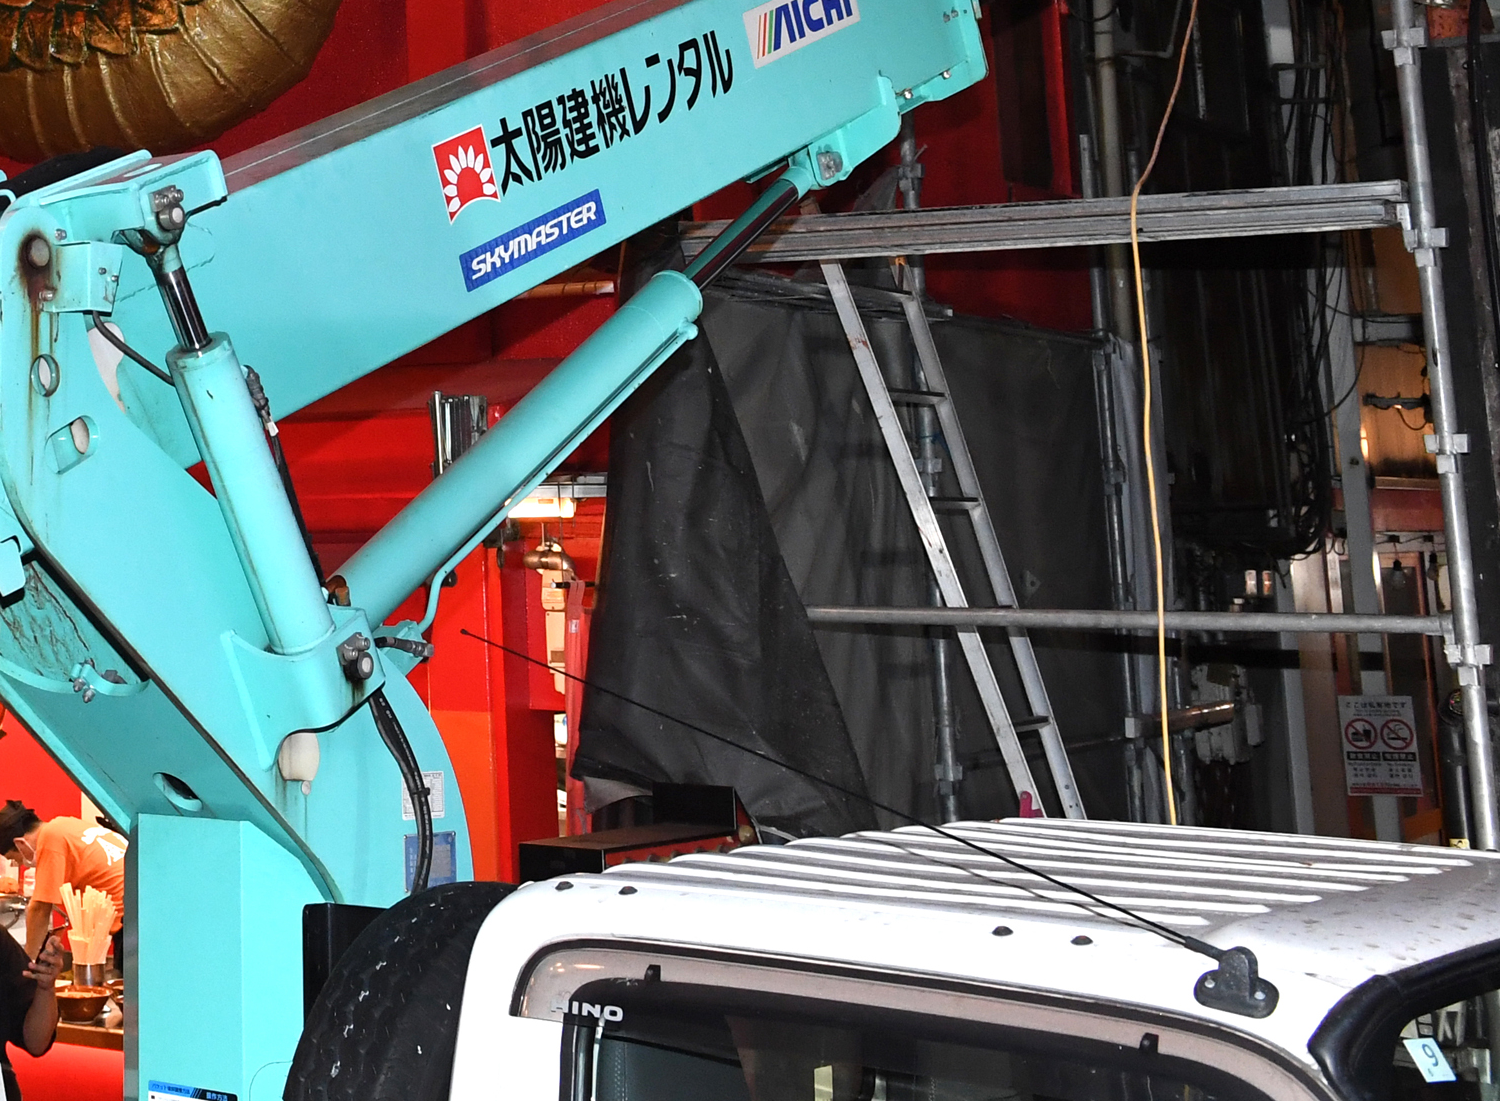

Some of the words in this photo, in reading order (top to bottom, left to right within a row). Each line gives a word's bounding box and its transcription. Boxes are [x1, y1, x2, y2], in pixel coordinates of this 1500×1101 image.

[490, 30, 734, 197] 太陽建機レンタル
[471, 200, 597, 280] SKYMASTER
[550, 999, 623, 1022] HINO
